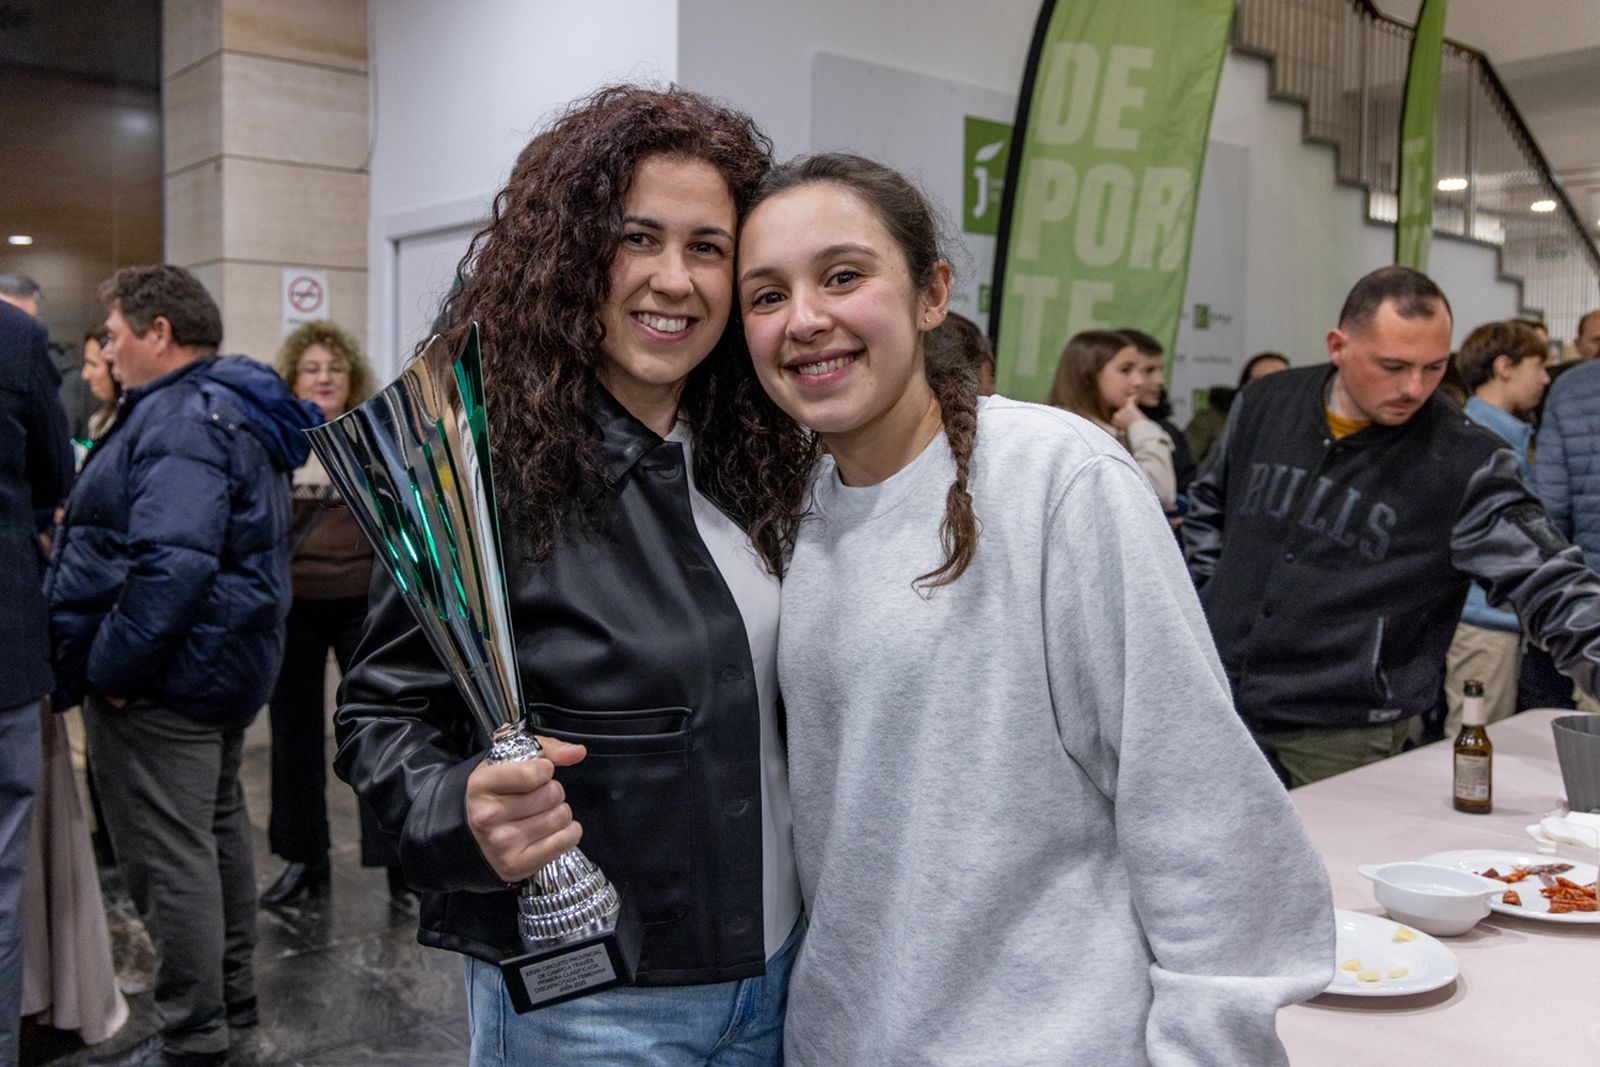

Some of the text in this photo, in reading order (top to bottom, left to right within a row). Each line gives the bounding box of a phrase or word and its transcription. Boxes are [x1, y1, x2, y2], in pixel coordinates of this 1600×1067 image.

[1034, 41, 1154, 152] DE
[1016, 158, 1193, 272] POR
[1235, 462, 1398, 562] BULLS
[537, 963, 599, 985] PRIMERA CLASIFICADA
[546, 966, 566, 976] CAMPO
